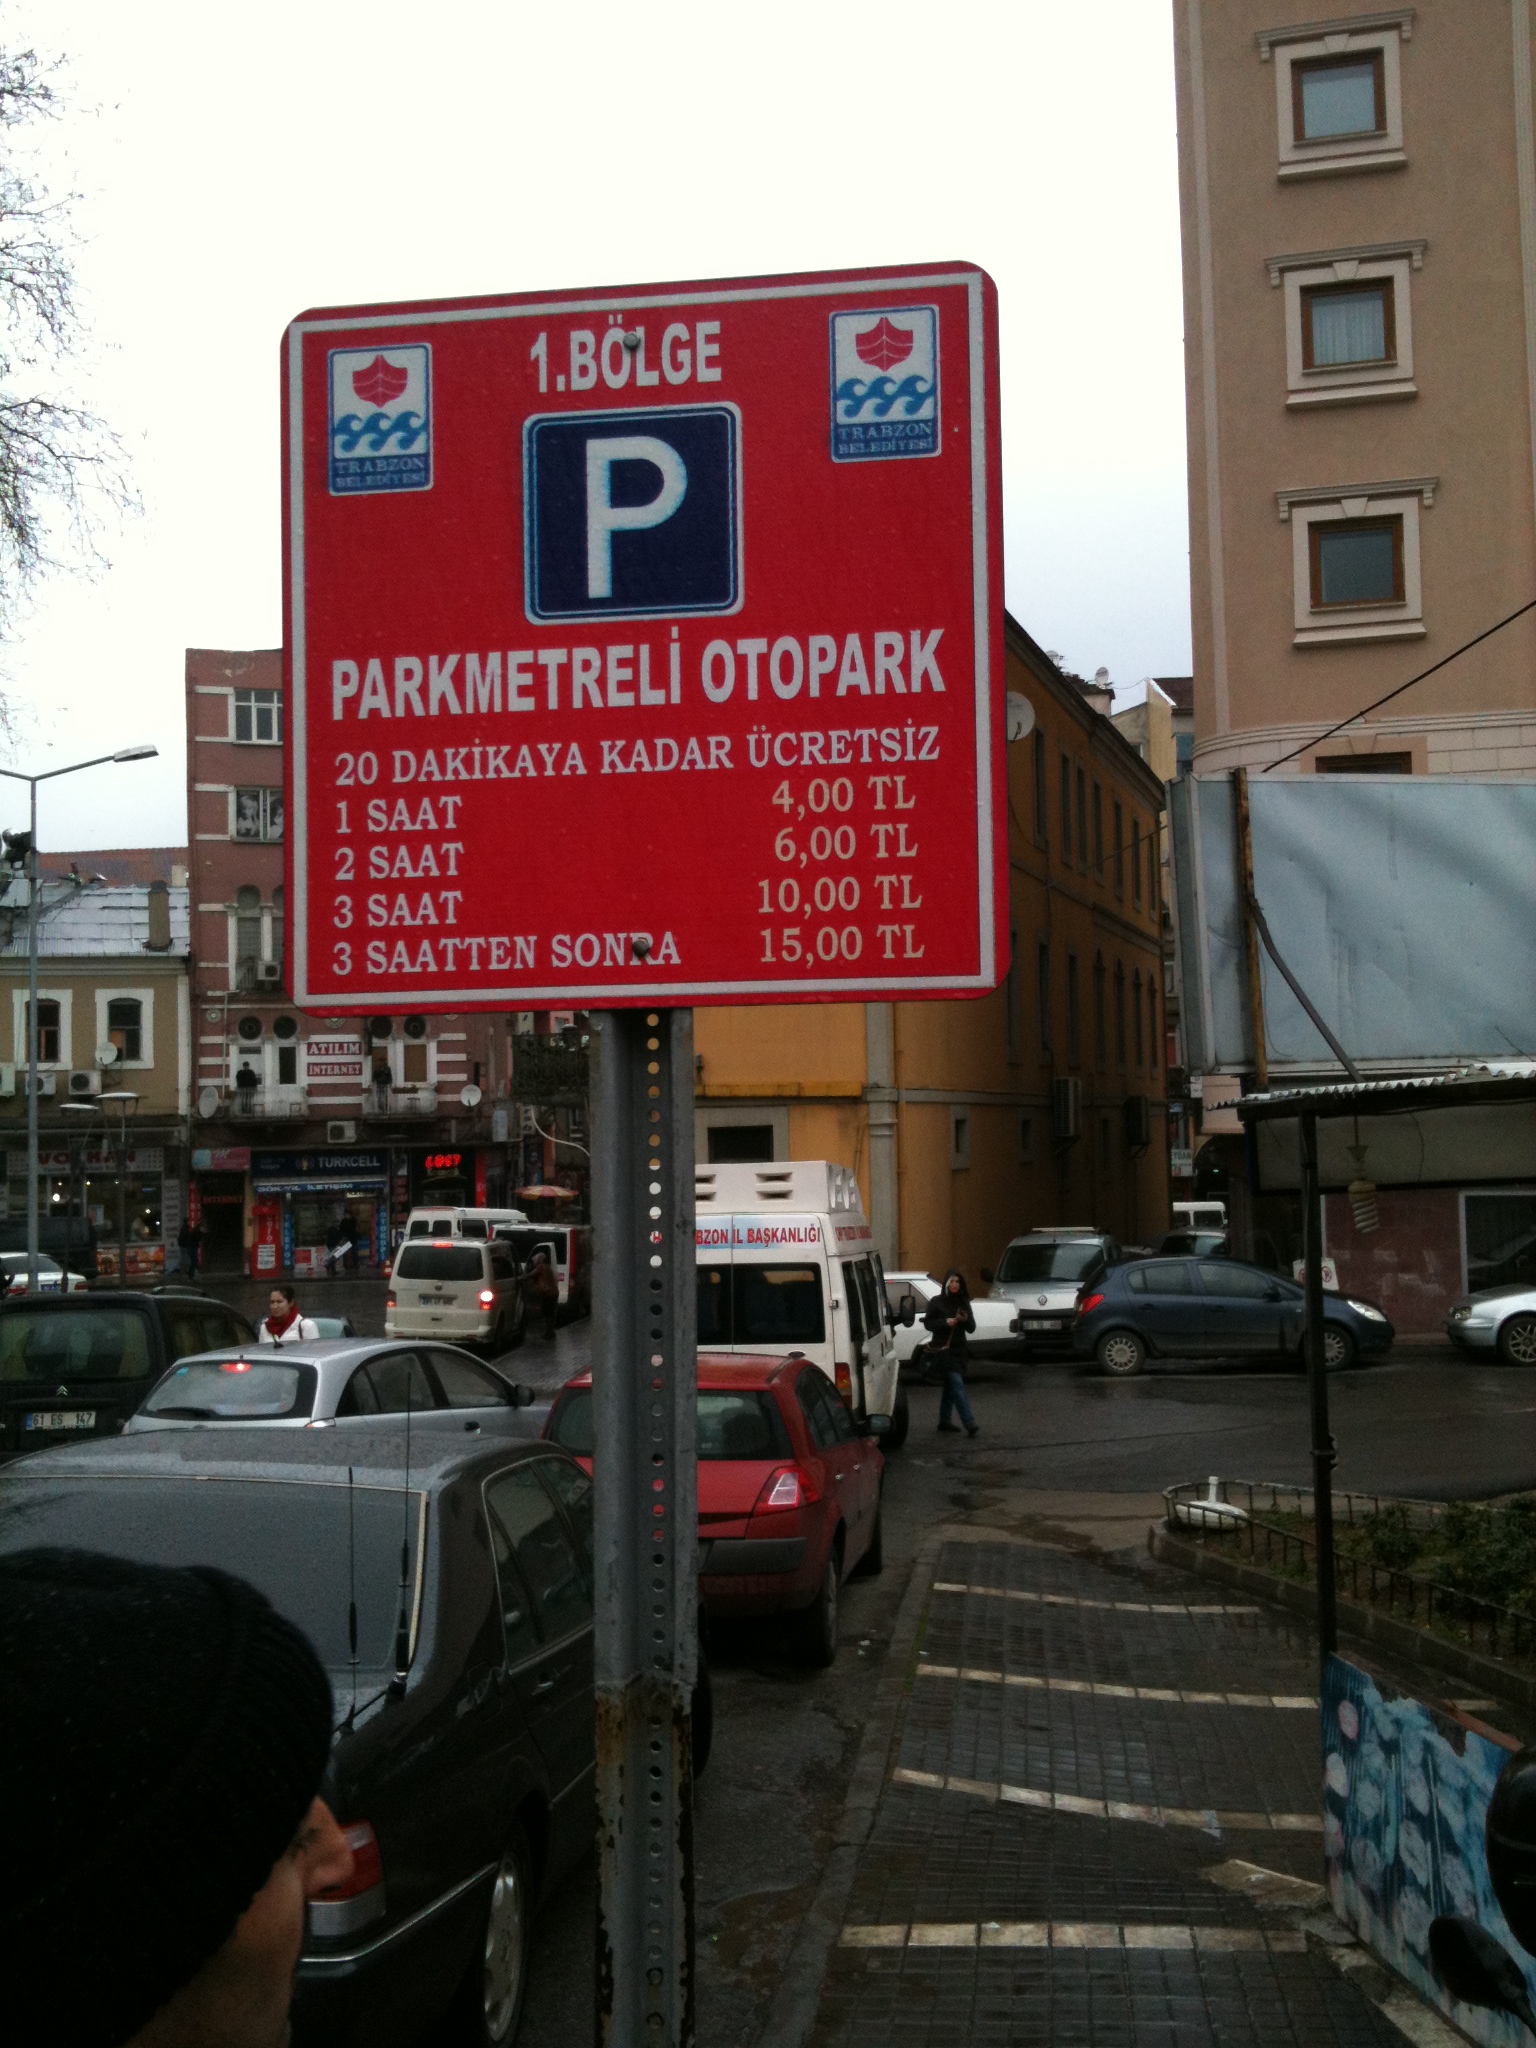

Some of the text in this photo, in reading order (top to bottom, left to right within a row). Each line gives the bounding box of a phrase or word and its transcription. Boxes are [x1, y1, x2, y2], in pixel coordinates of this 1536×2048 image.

[530, 314, 722, 393] 1.BÖLGE
[838, 422, 933, 440] TRABZON
[335, 457, 425, 474] TRABZON
[585, 436, 688, 598] P
[332, 626, 946, 721] PARKMETRELİ OTOPARK
[336, 719, 940, 787] 20 DAKİKAYA KADAR ÜCRETSİZ
[336, 776, 917, 834] 1 SAAT 4,00 TL
[335, 825, 918, 881] 2 SAAT 6,00 TL
[334, 876, 922, 929] 3 SAAT 10,00 TL
[333, 925, 925, 976] 3 SAATTEN SONRA 15,00 TL
[309, 1043, 361, 1055] ATILIM
[317, 1155, 381, 1168] TURKCELL
